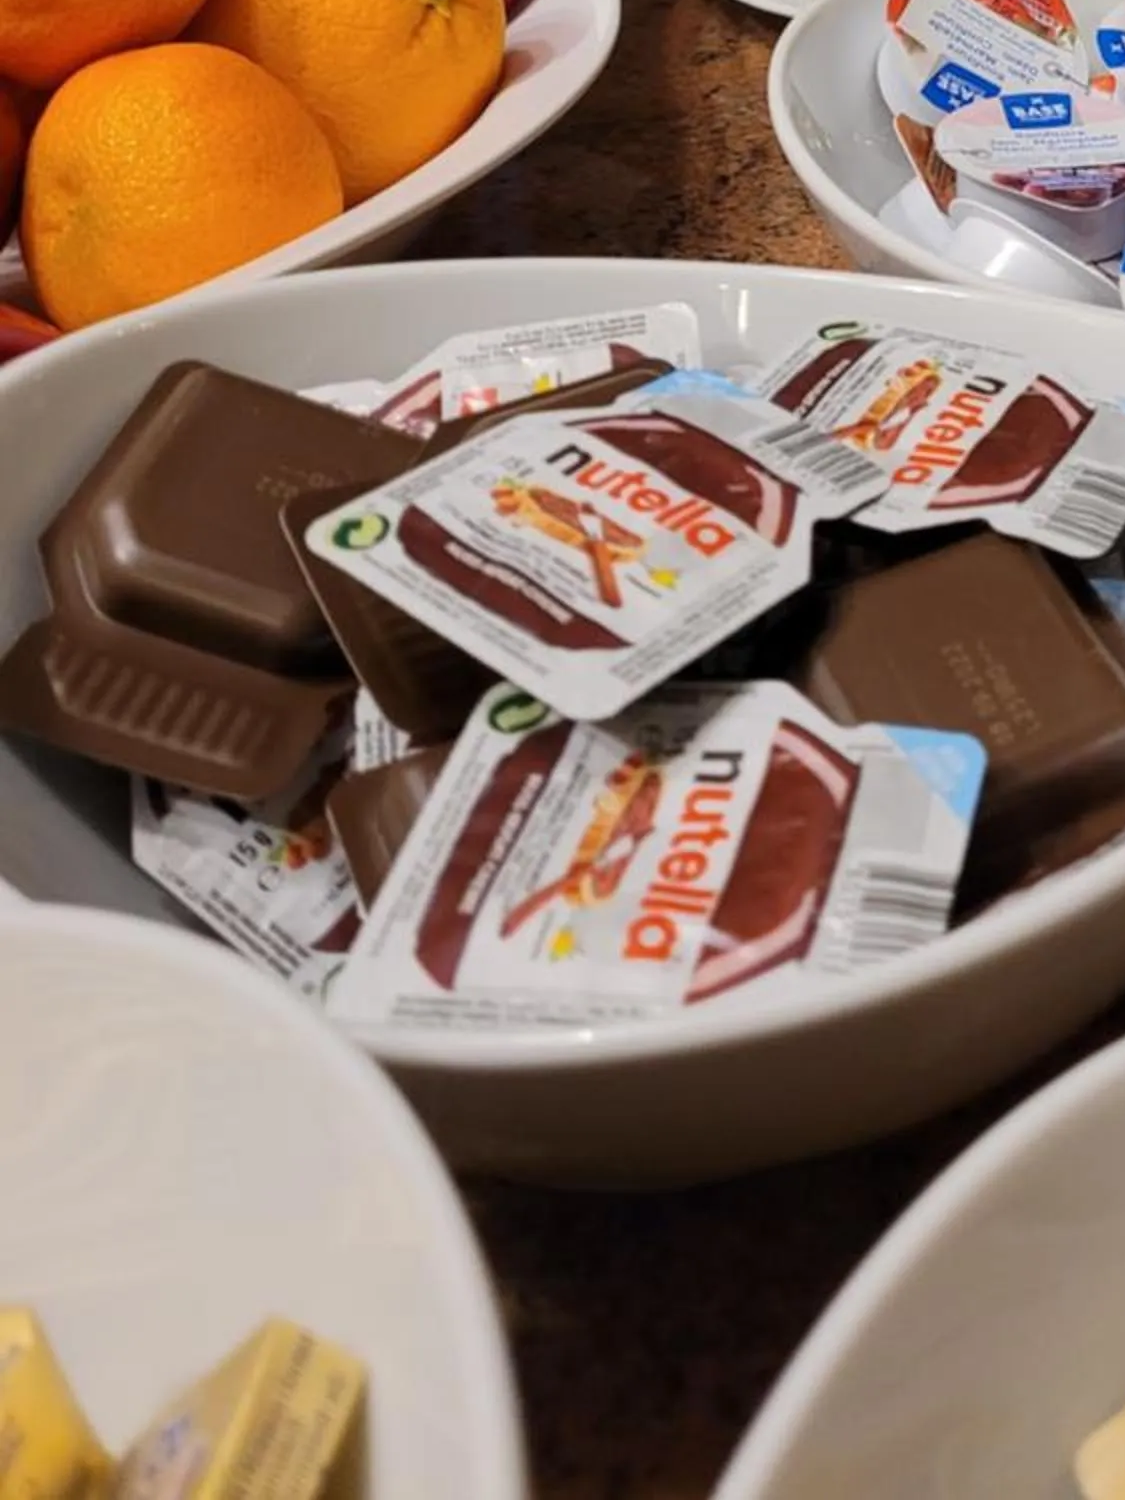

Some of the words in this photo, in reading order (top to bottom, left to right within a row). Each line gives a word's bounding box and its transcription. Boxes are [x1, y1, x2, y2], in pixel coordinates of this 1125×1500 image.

[1012, 103, 1066, 120] BASE
[893, 373, 1007, 487] nutella
[547, 443, 736, 559] nutella
[228, 839, 259, 869] 15
[622, 746, 743, 964] nutella
